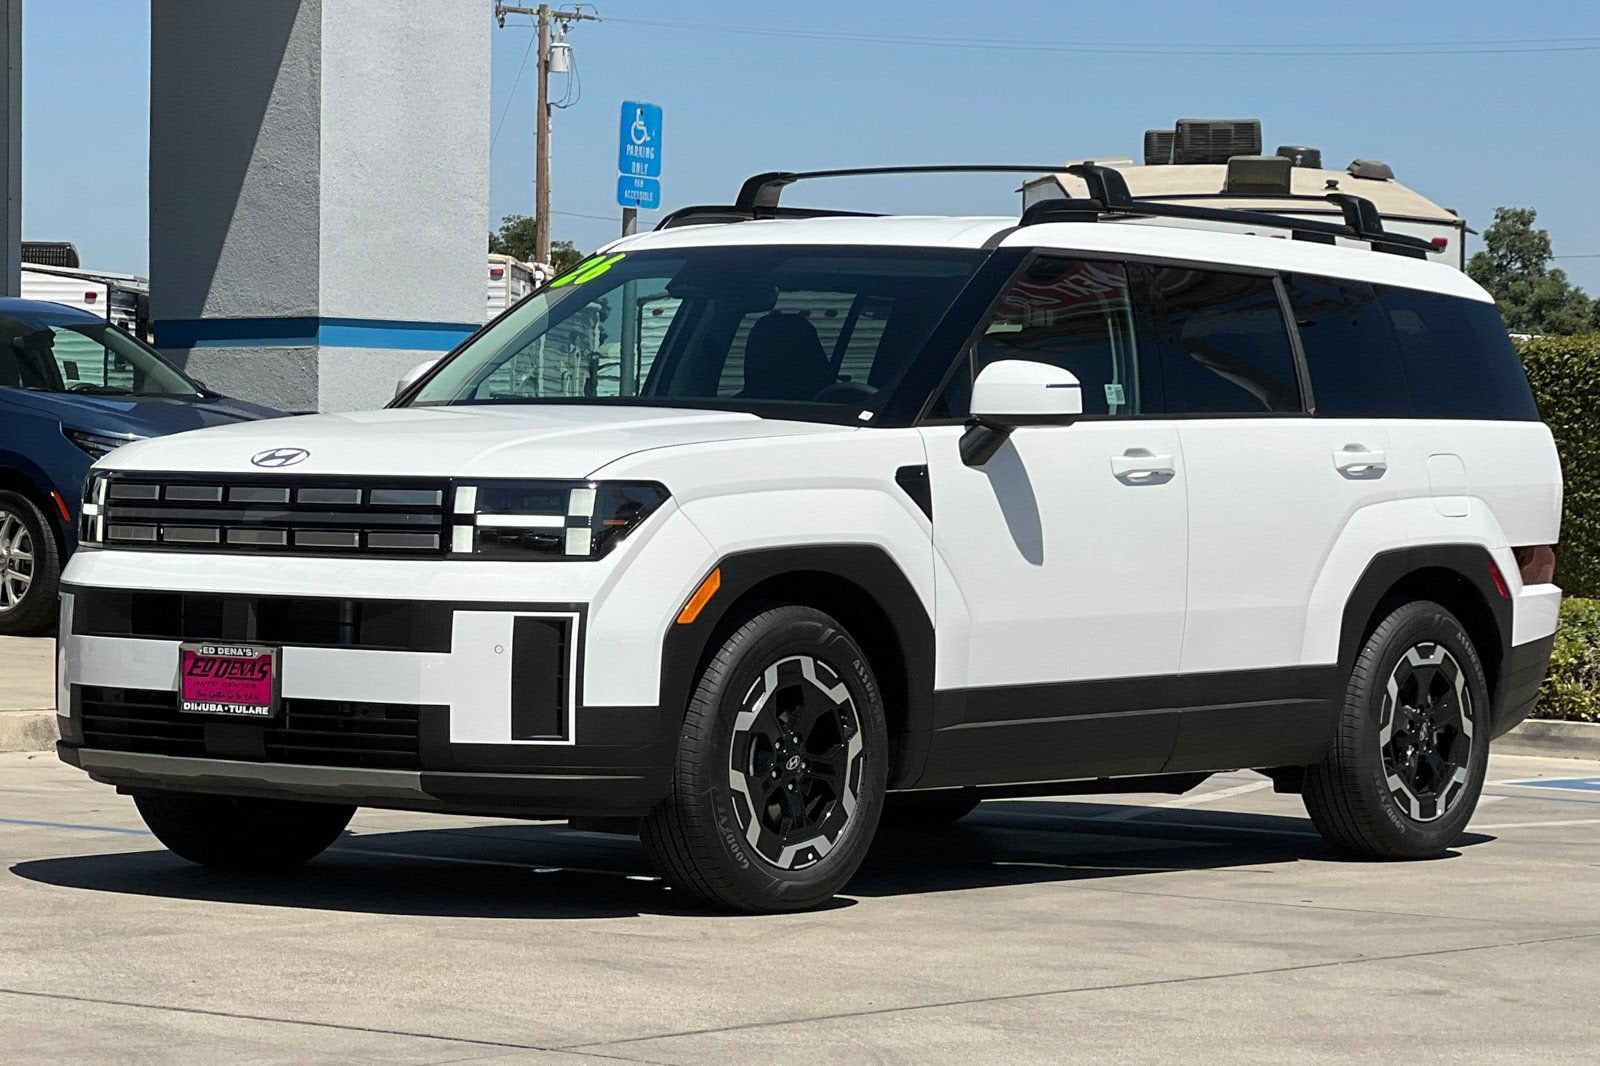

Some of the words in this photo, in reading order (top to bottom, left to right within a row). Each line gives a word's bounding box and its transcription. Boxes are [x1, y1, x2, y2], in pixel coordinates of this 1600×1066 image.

[626, 144, 655, 159] PARKING
[631, 161, 649, 175] ONLY
[202, 646, 216, 655] ED
[217, 647, 253, 656] DENA'S
[187, 657, 216, 677] ED
[229, 705, 269, 715] TULARE
